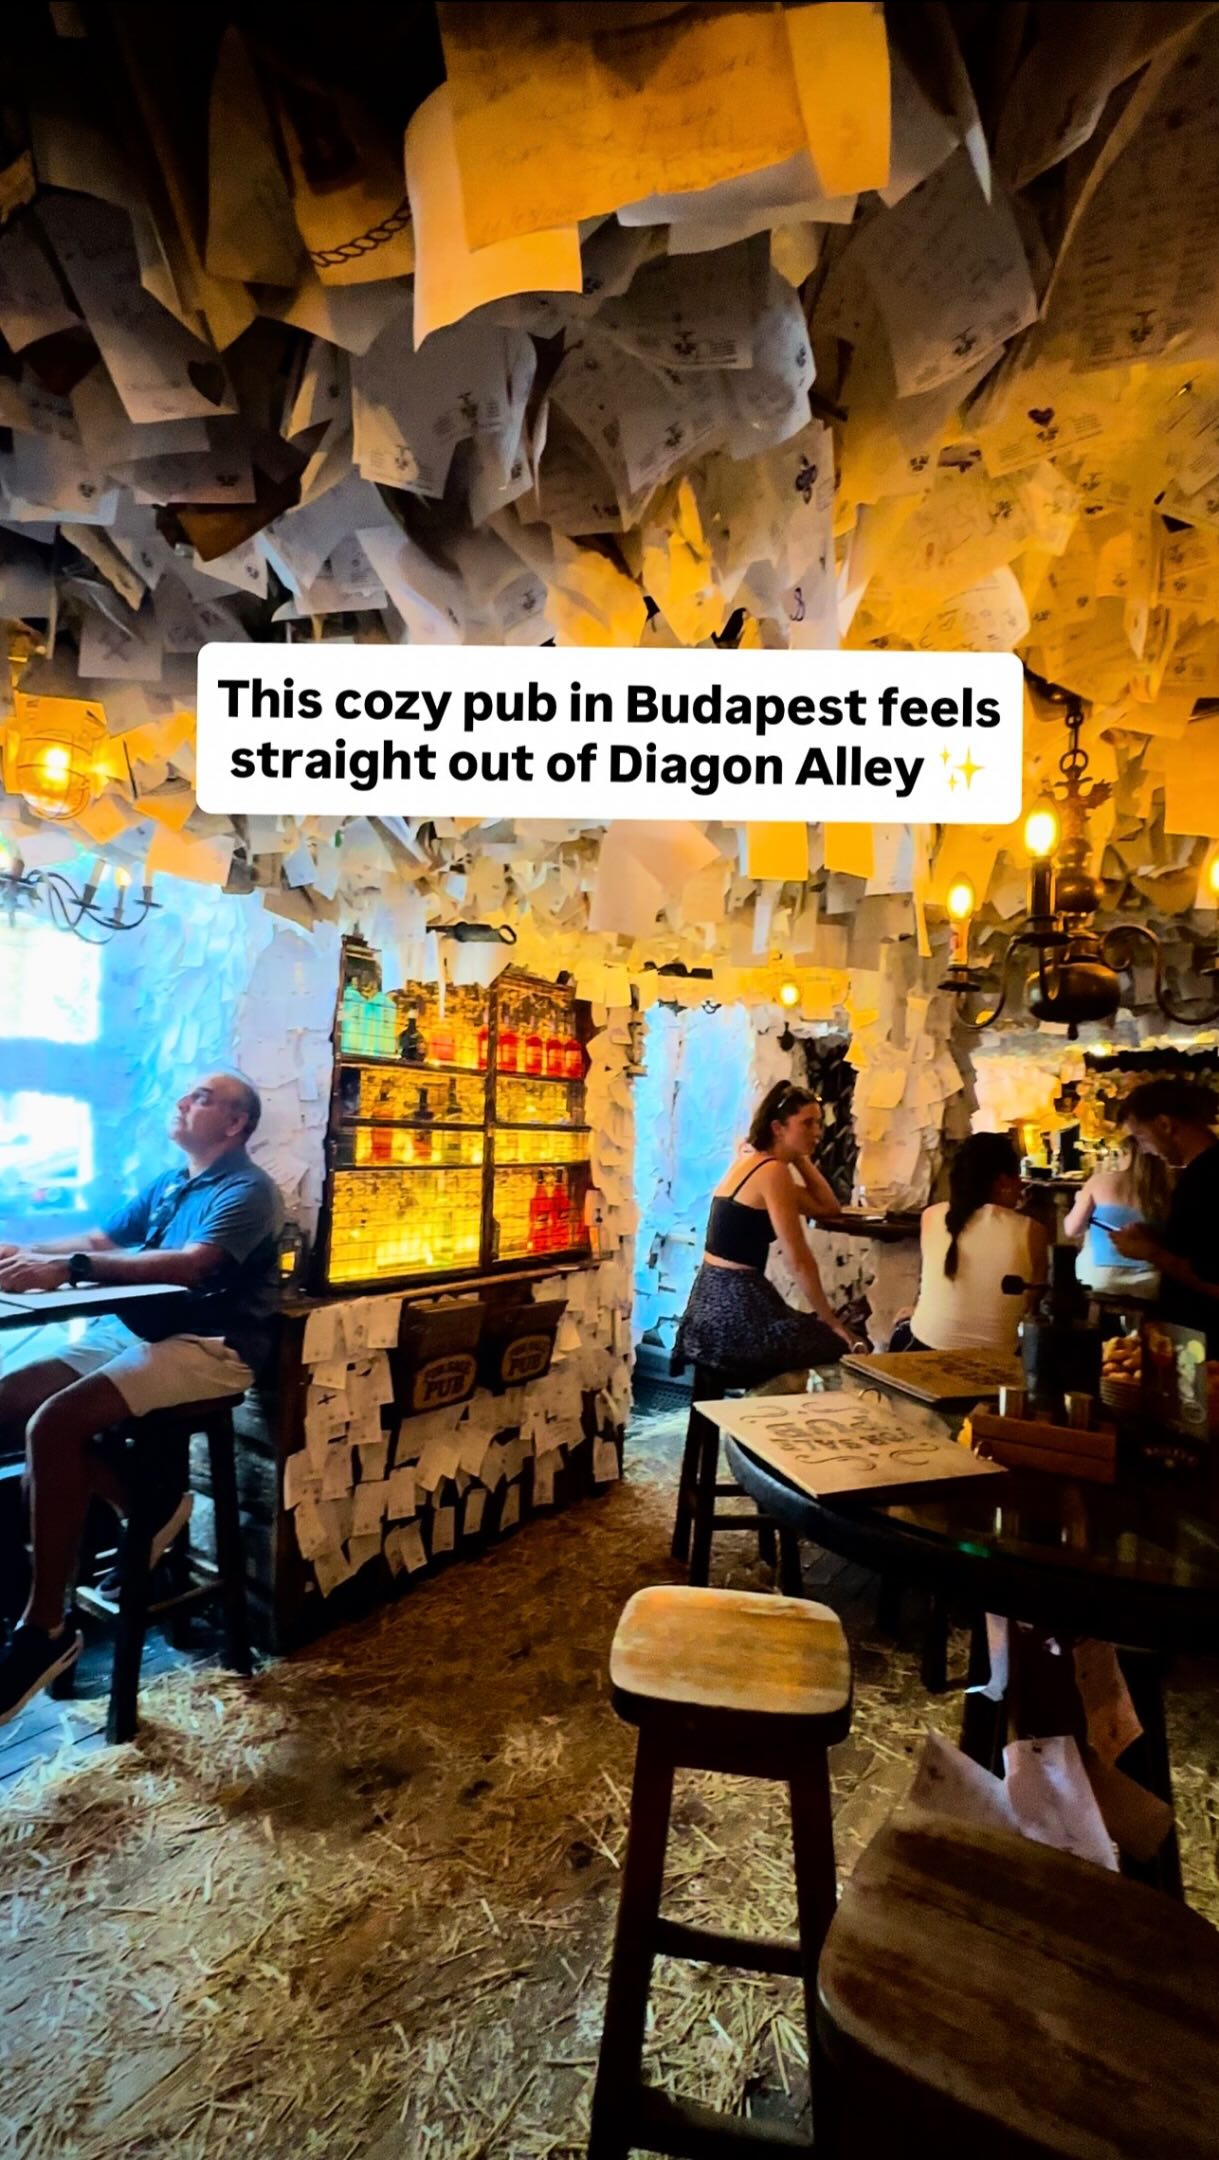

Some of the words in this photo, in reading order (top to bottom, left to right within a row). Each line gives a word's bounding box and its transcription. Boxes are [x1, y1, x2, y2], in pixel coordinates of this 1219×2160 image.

[424, 1375, 465, 1402] PUB
[765, 1416, 876, 1438] PUB
[768, 1438, 864, 1452] SALE
